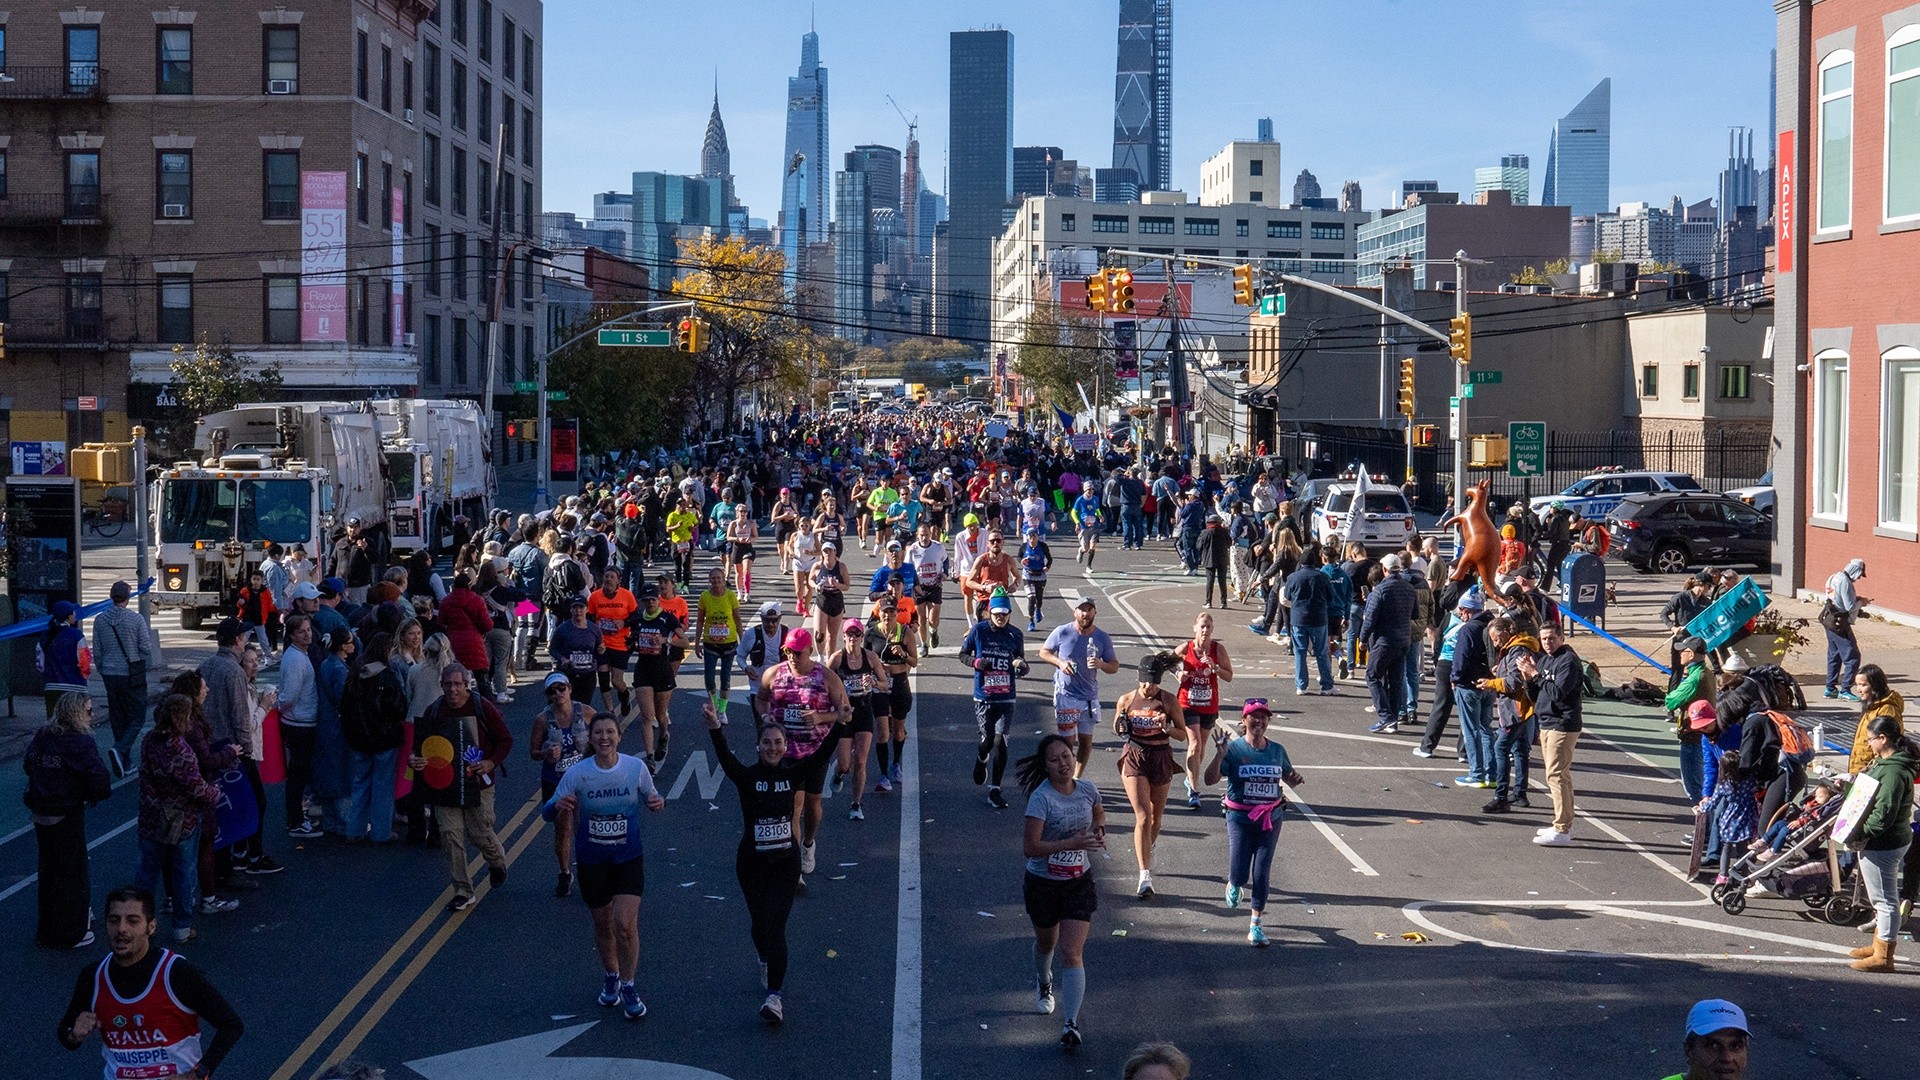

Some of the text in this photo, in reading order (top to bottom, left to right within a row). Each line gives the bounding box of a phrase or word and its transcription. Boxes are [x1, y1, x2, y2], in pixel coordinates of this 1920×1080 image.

[1782, 164, 1790, 240] APEX
[305, 213, 342, 237] 551
[304, 241, 343, 262] 697
[305, 267, 343, 282] 5877
[310, 290, 338, 301] Raw/
[621, 334, 648, 343] 11 St
[1477, 373, 1484, 382] 11
[156, 397, 177, 406] BAR
[756, 780, 791, 792] GO JULI
[1248, 783, 1274, 794] 41401
[587, 787, 630, 799] CAMILA
[591, 822, 625, 832] 43008
[758, 824, 789, 837] 28108
[1053, 851, 1083, 862] 42275
[1709, 1007, 1736, 1015] wahoo
[107, 1029, 168, 1045] ITALIA
[114, 1049, 168, 1064] GIUSEPPE
[123, 1068, 135, 1077] tcs
